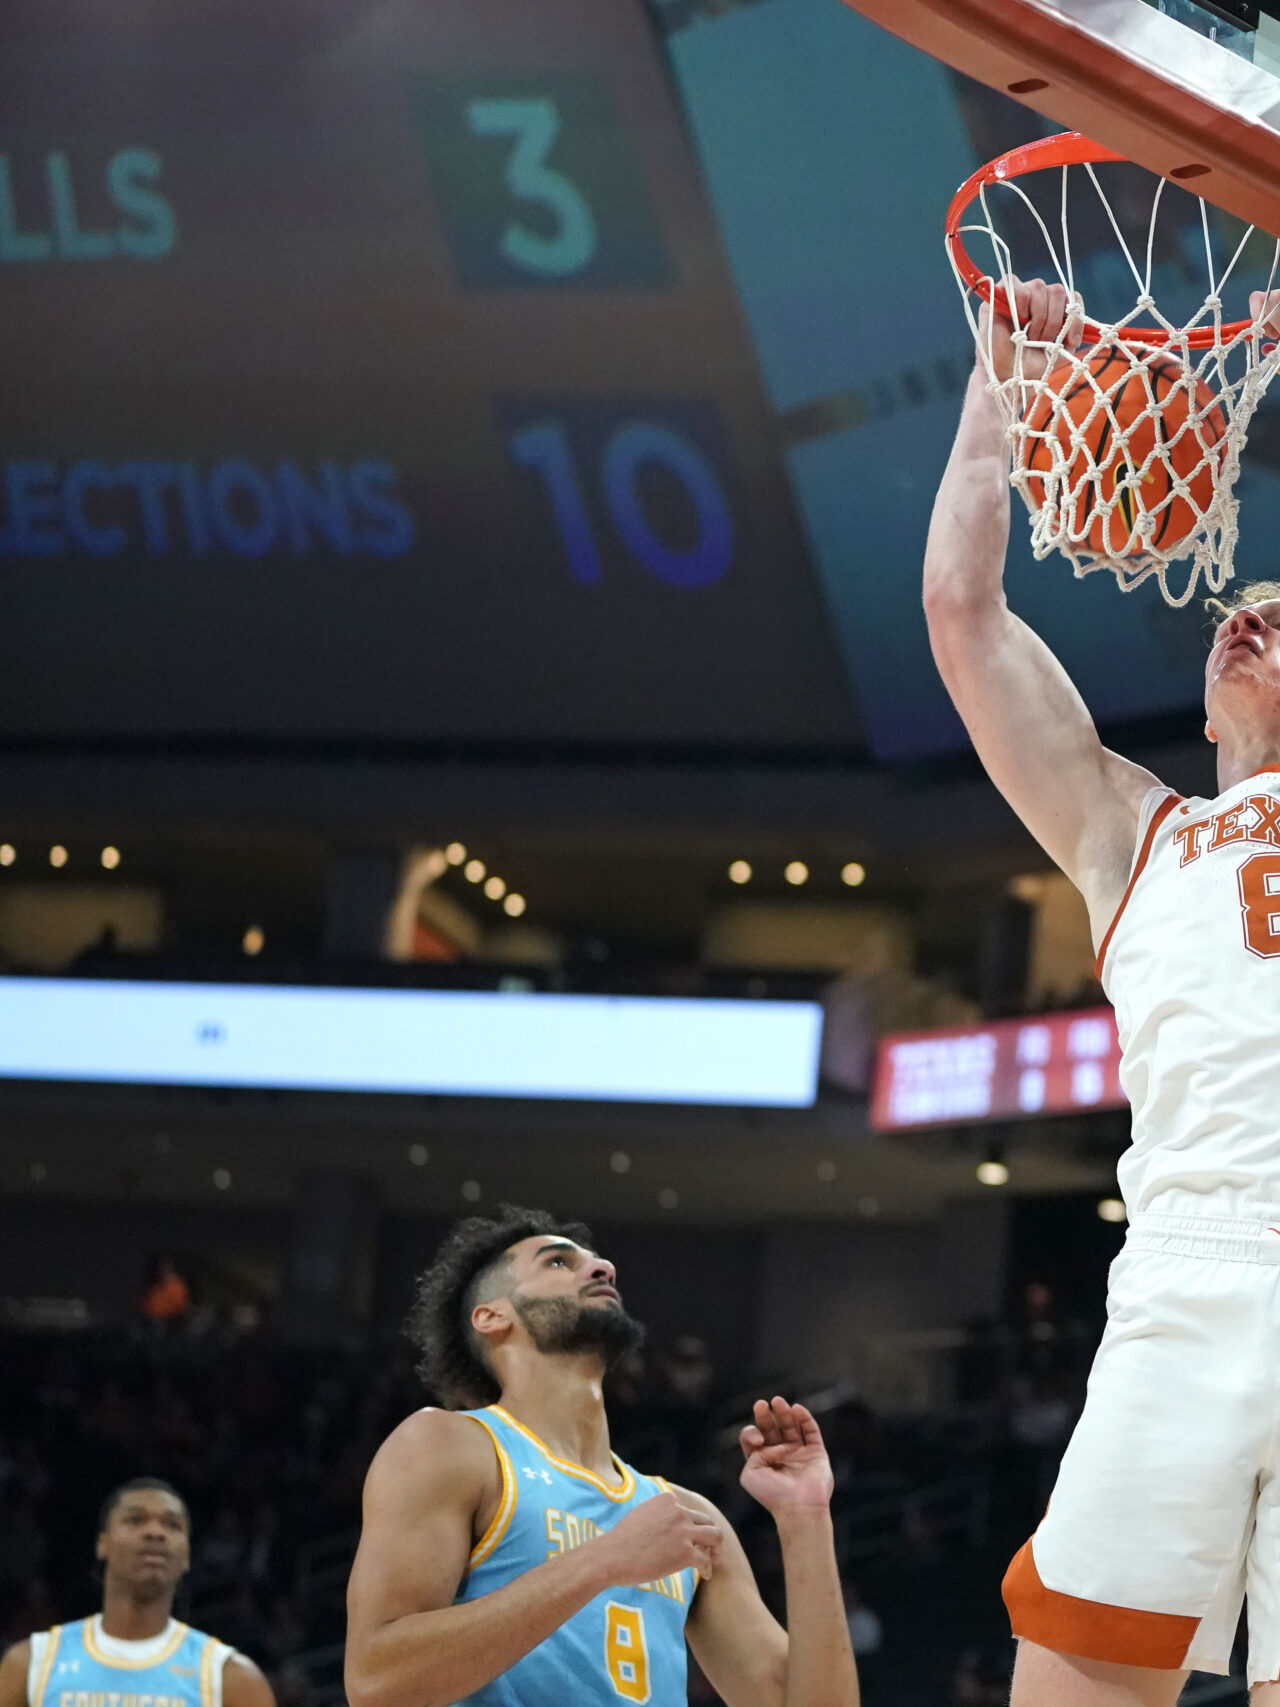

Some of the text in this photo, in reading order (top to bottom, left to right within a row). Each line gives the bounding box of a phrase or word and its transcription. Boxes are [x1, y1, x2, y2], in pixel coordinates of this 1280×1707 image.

[467, 97, 596, 277] 3
[0, 421, 735, 590] ECTIONS 10
[604, 1599, 651, 1706] 8
